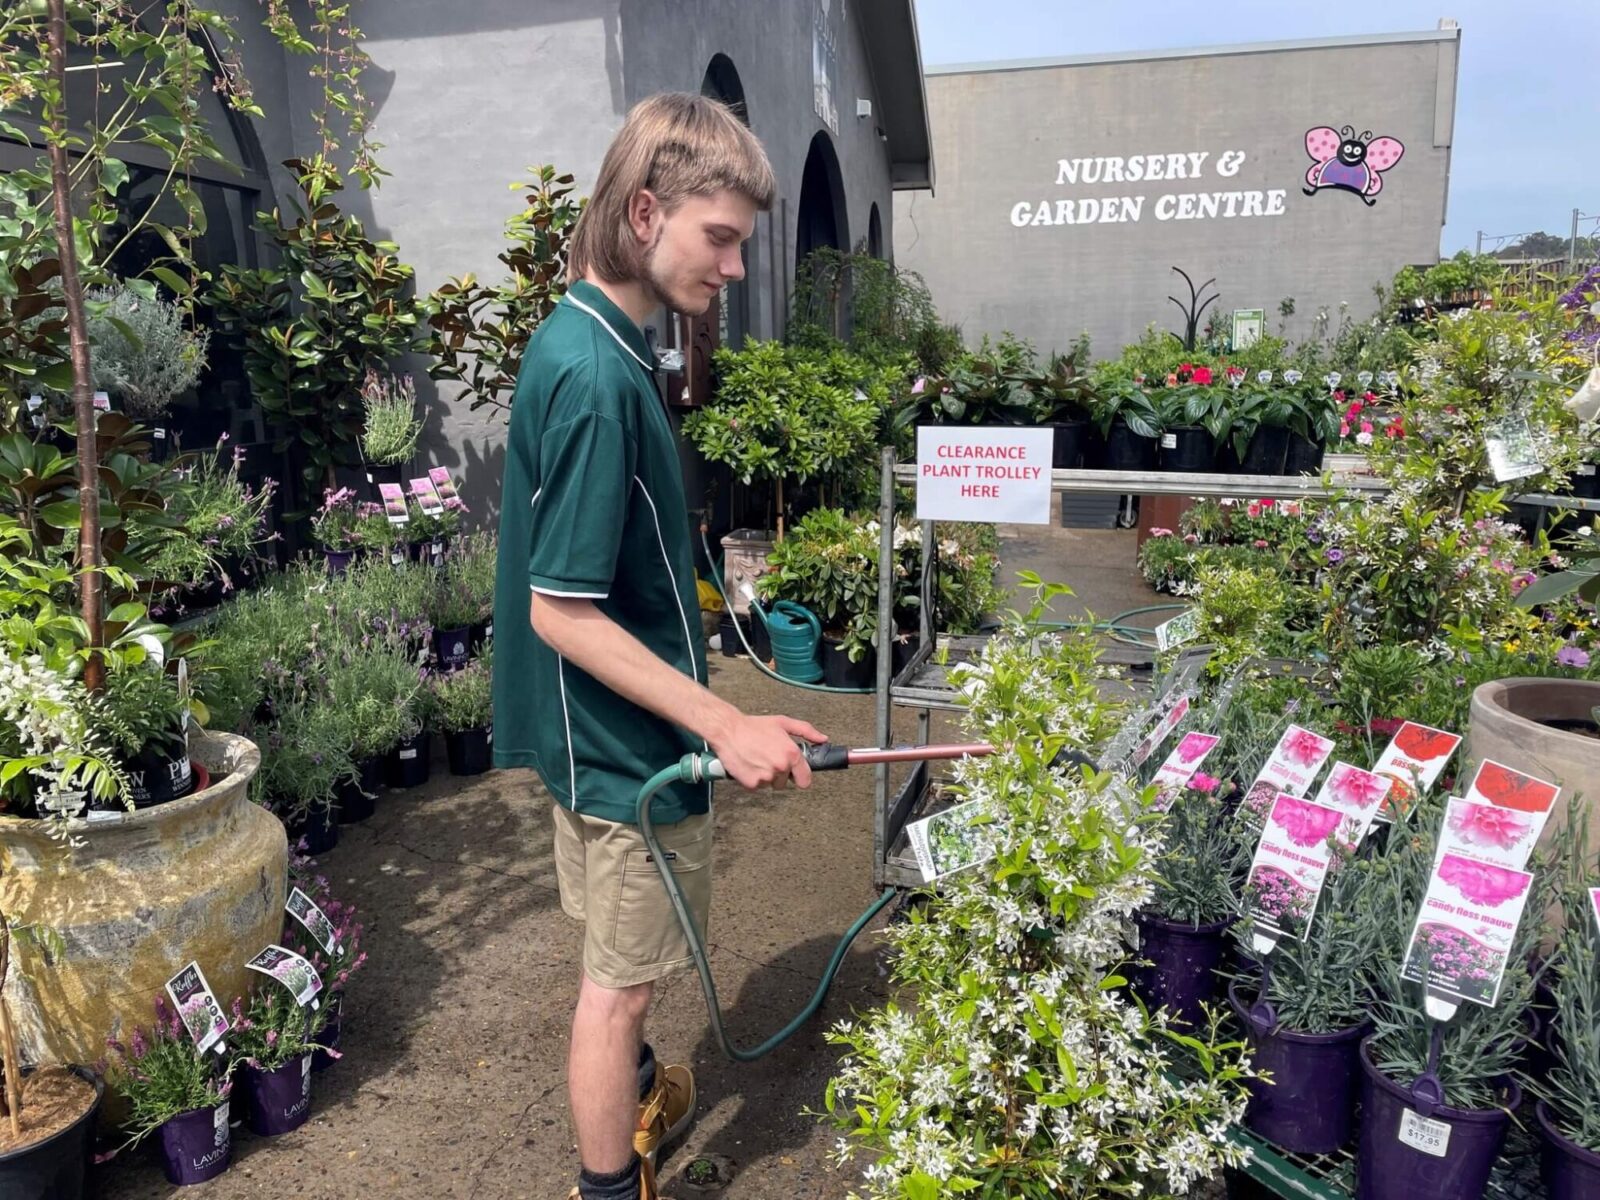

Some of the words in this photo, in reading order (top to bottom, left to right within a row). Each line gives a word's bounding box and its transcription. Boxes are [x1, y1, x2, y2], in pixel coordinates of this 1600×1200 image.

[1055, 151, 1208, 185] NURSERY
[1216, 150, 1246, 177] &
[1010, 195, 1144, 227] GARDEN
[1154, 189, 1287, 221] CENTRE
[937, 445, 1027, 459] CLEARANCE
[922, 464, 971, 478] PLANT
[975, 466, 1041, 480] TROLLEY
[961, 485, 1000, 498] HERE
[1261, 843, 1281, 856] candy
[1282, 849, 1300, 861] floss
[1300, 855, 1325, 869] mauve
[1427, 899, 1456, 914] candy
[1456, 906, 1479, 920] floss
[1481, 914, 1513, 930] mauve
[1408, 1128, 1440, 1147] $17.95
